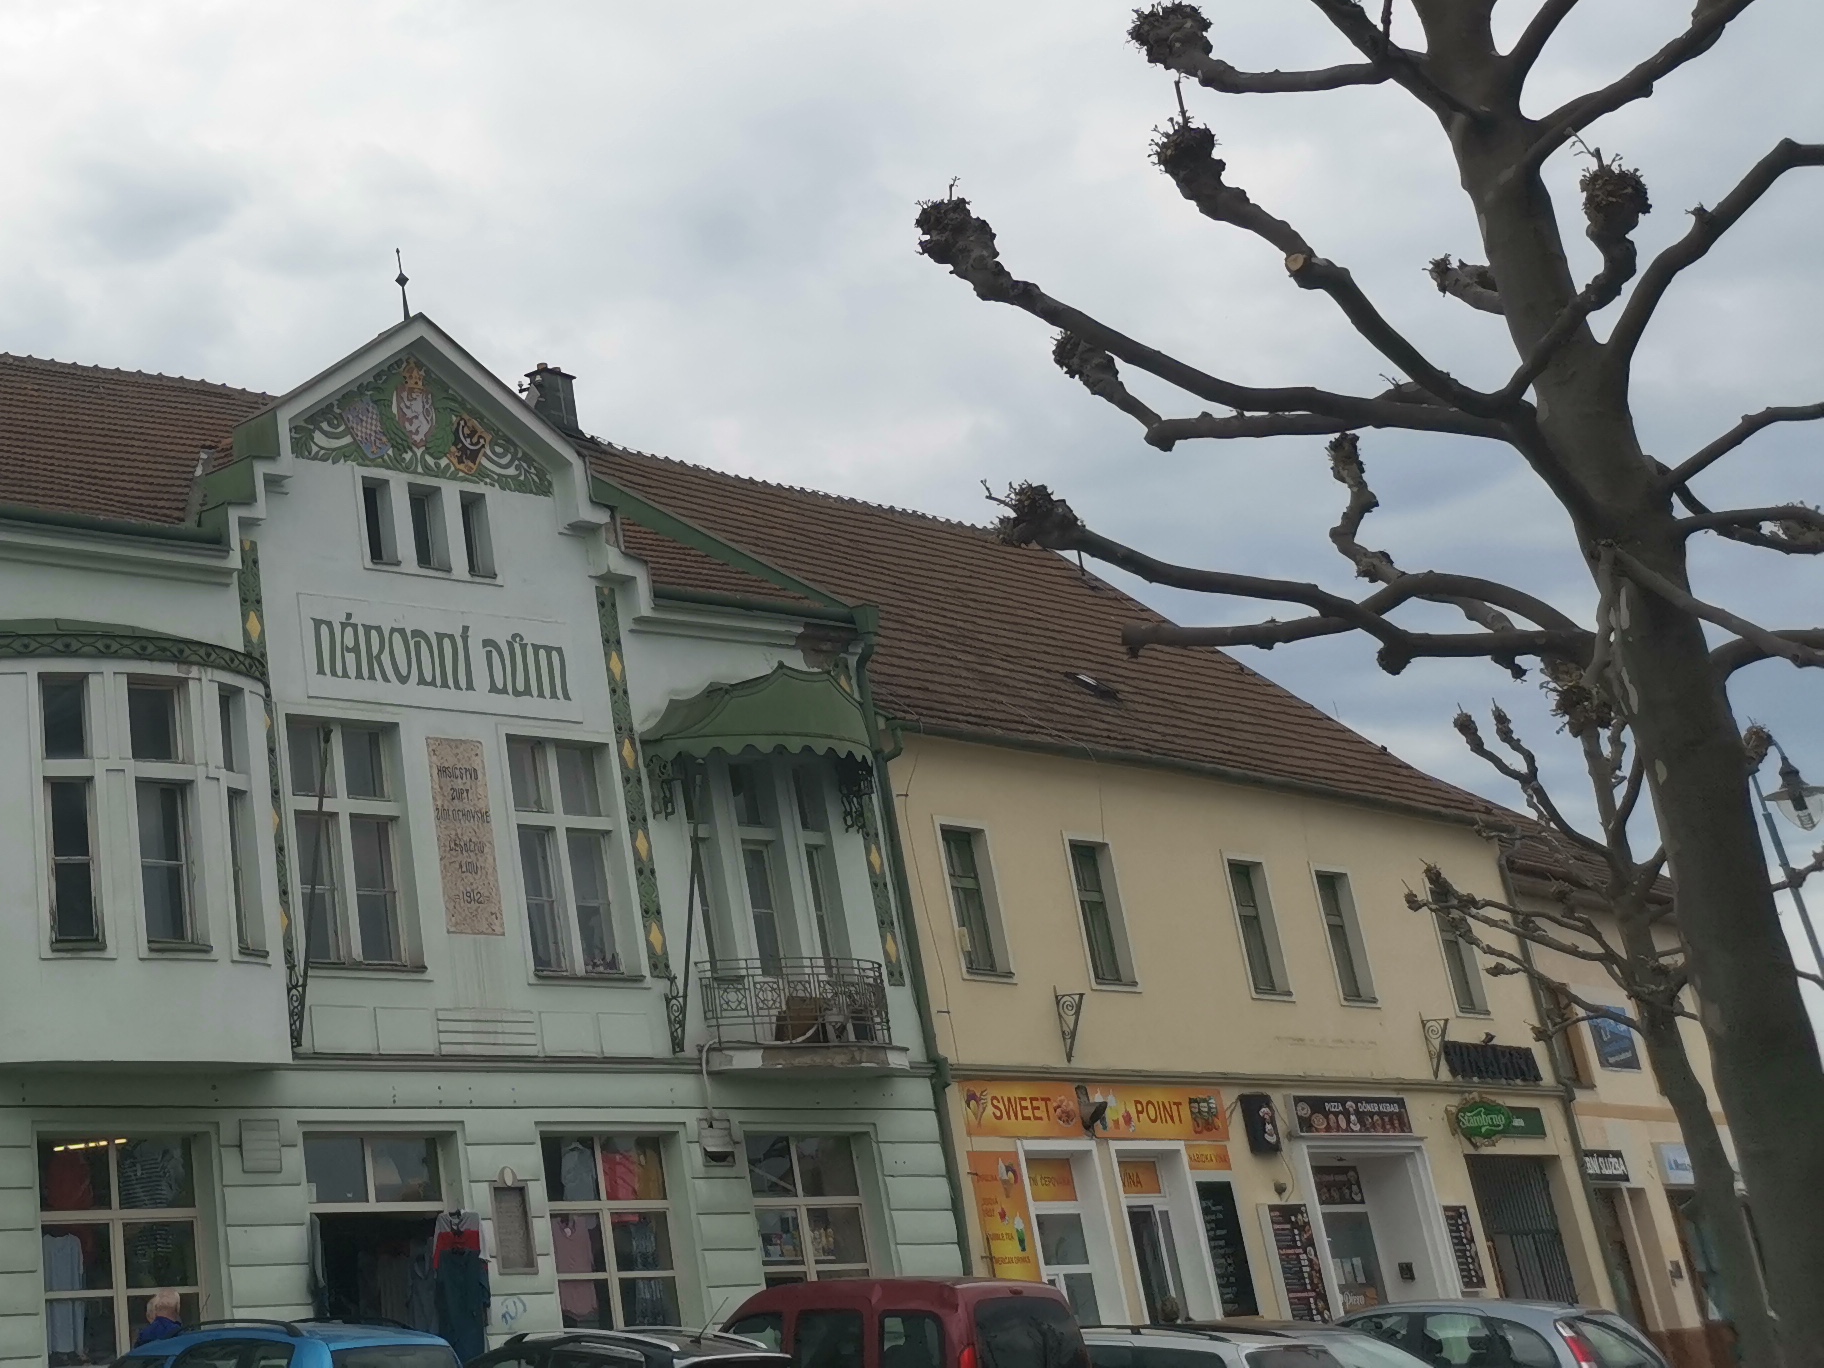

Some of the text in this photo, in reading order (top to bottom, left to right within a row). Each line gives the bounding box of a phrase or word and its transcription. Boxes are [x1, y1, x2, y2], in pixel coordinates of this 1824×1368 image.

[309, 611, 573, 702] NÁRODNÍ DŮM
[990, 1095, 1183, 1125] SWEET POINT
[1325, 1101, 1344, 1112] PIZZA
[1379, 1102, 1400, 1113] KEBAB
